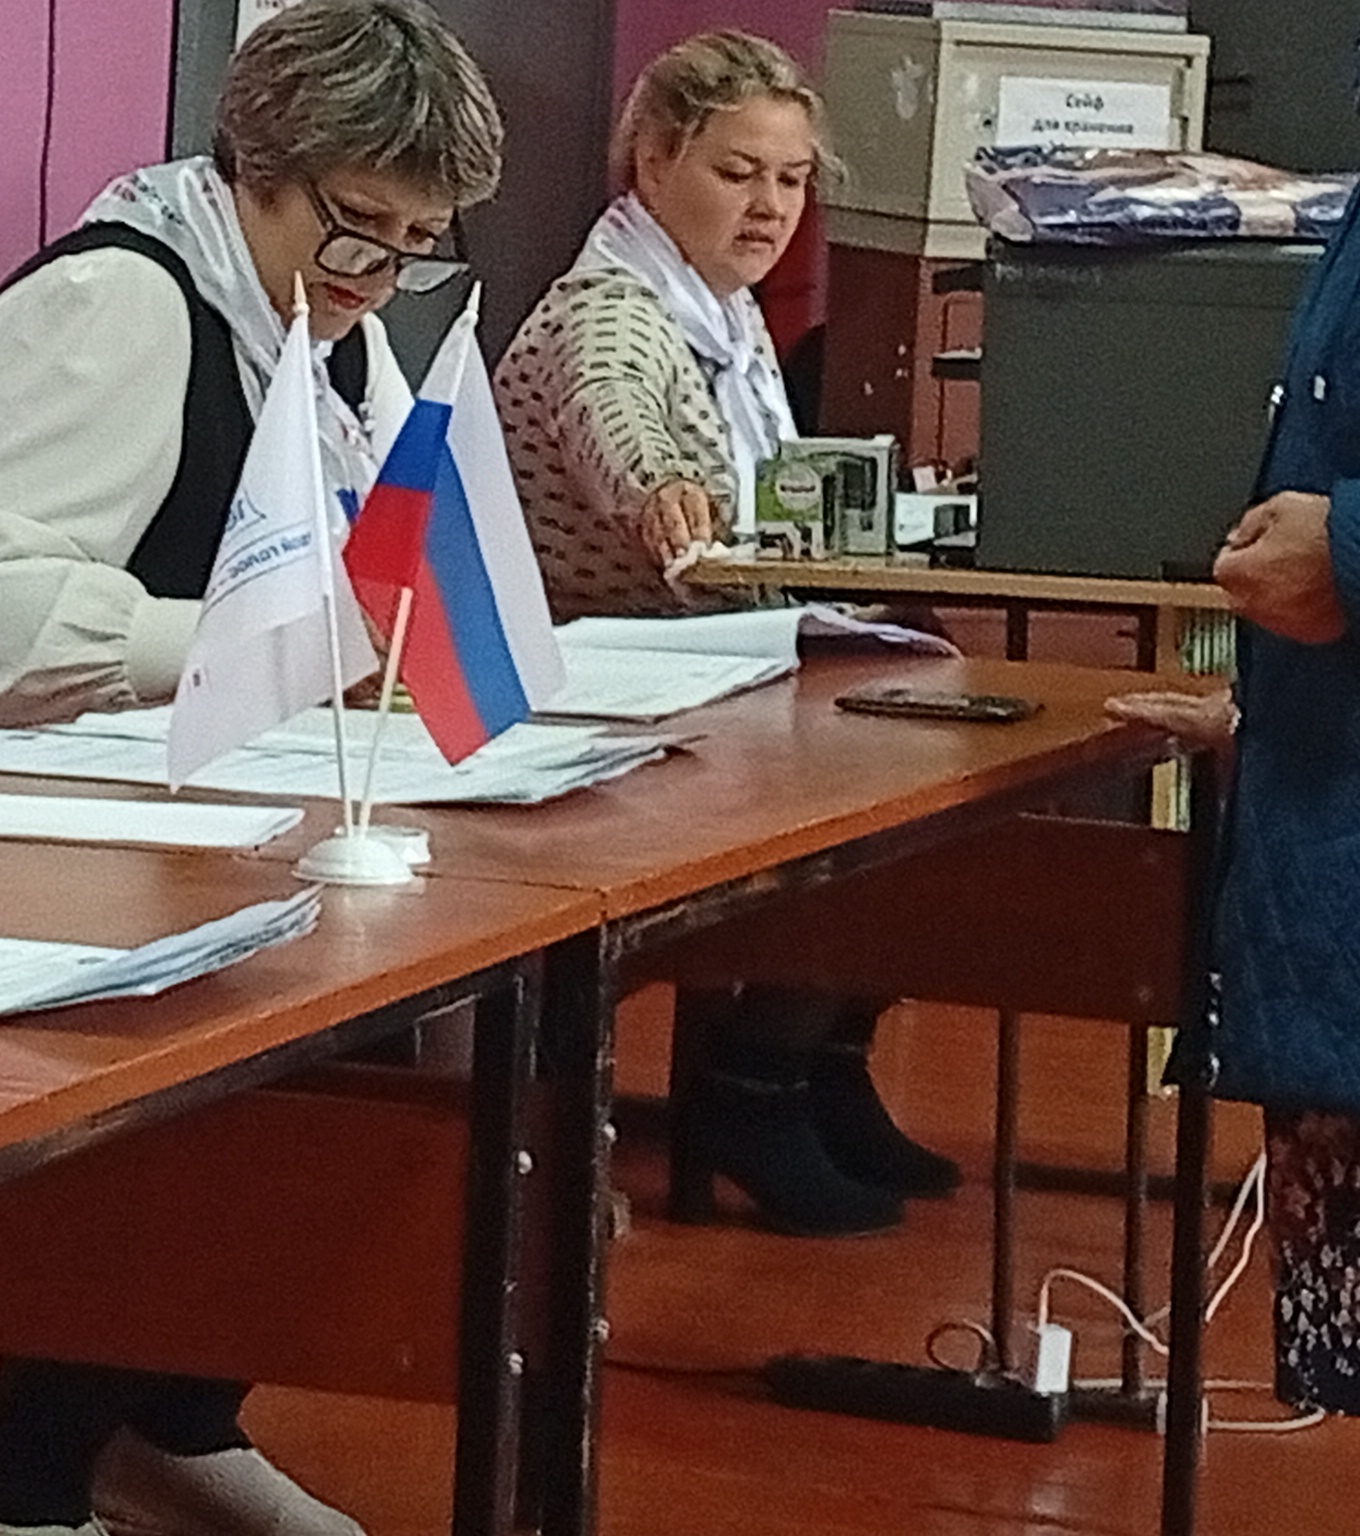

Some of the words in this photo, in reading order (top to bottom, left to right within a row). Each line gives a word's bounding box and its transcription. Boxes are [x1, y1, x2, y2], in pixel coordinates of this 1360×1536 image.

[1066, 93, 1105, 112] Сейф
[1032, 119, 1060, 133] для
[1064, 120, 1134, 136] хранения
